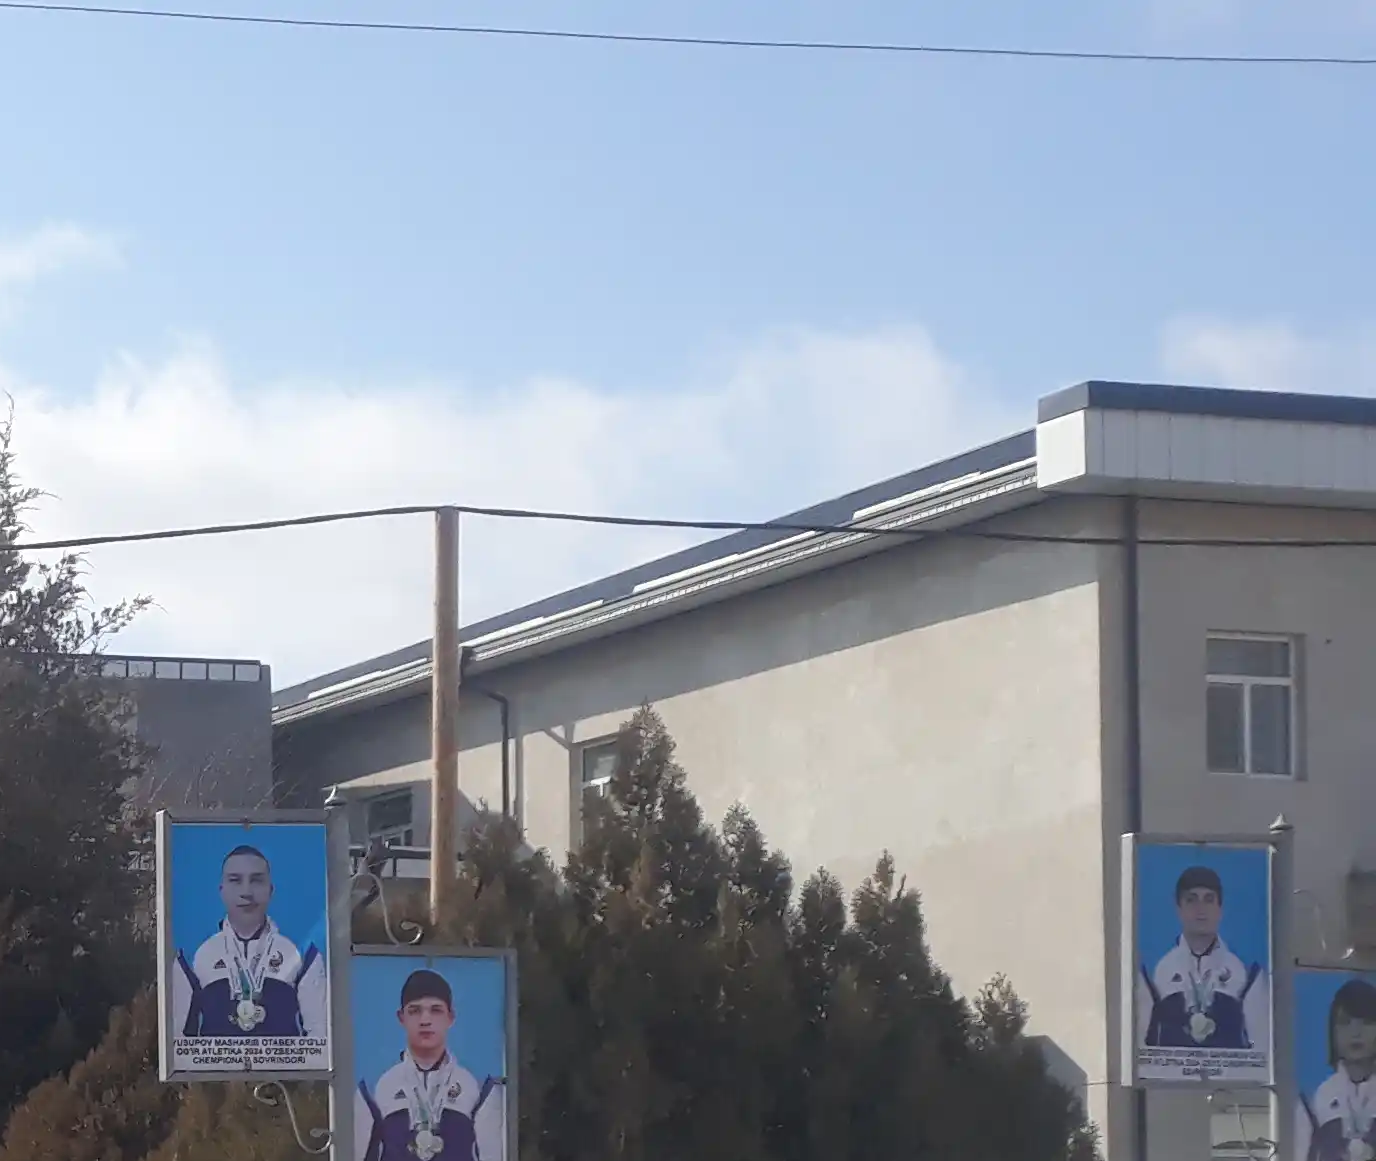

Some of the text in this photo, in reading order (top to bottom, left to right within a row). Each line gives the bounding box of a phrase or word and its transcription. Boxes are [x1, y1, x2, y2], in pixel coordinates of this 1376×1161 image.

[262, 1038, 296, 1047] OTABEK
[201, 1047, 242, 1056] ATLETIKA
[265, 1047, 322, 1056] O'ZBEKISTON
